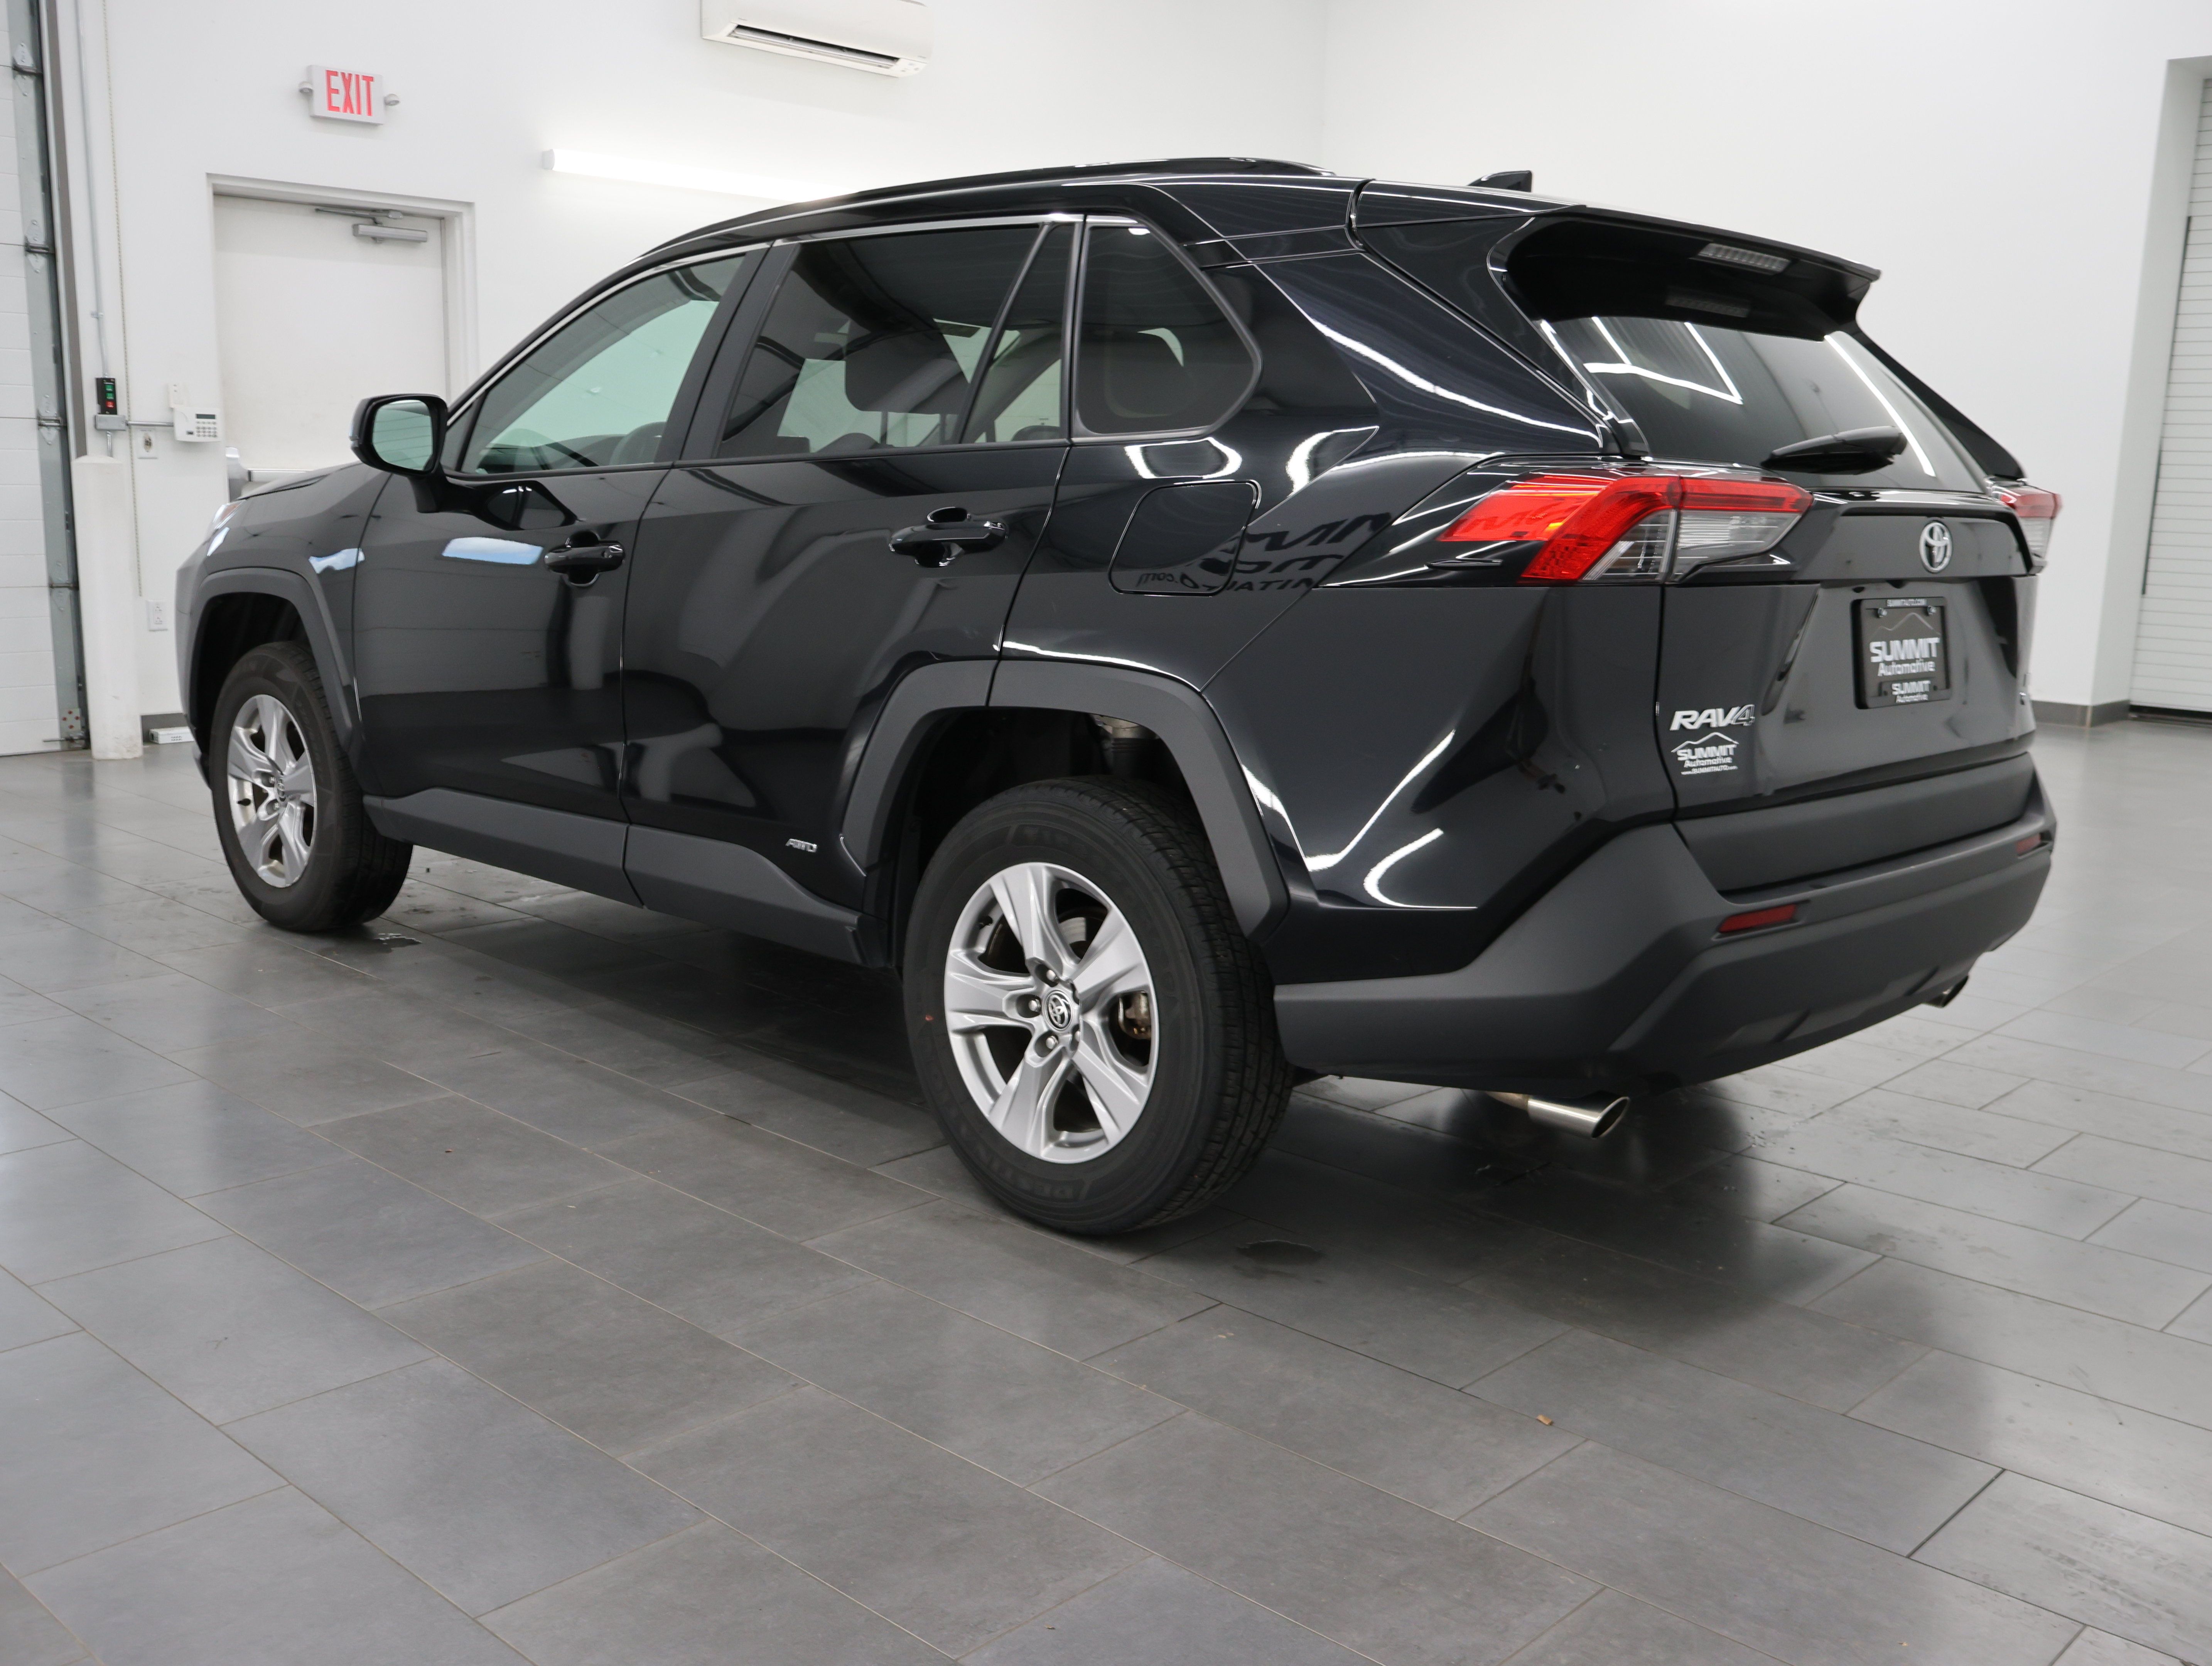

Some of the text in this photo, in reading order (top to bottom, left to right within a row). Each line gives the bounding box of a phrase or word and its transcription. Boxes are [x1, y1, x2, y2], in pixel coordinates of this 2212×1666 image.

[326, 70, 375, 116] EXIT
[1869, 637, 1940, 663] SUMMIT
[1877, 659, 1936, 676] Automotive
[1891, 680, 1931, 695] SUMMIT
[1896, 693, 1929, 703] Automotive
[1669, 704, 1756, 731] RAV4
[1677, 744, 1737, 761] SUMMIT
[1684, 757, 1733, 768] Automotive
[785, 838, 818, 853] AWD
